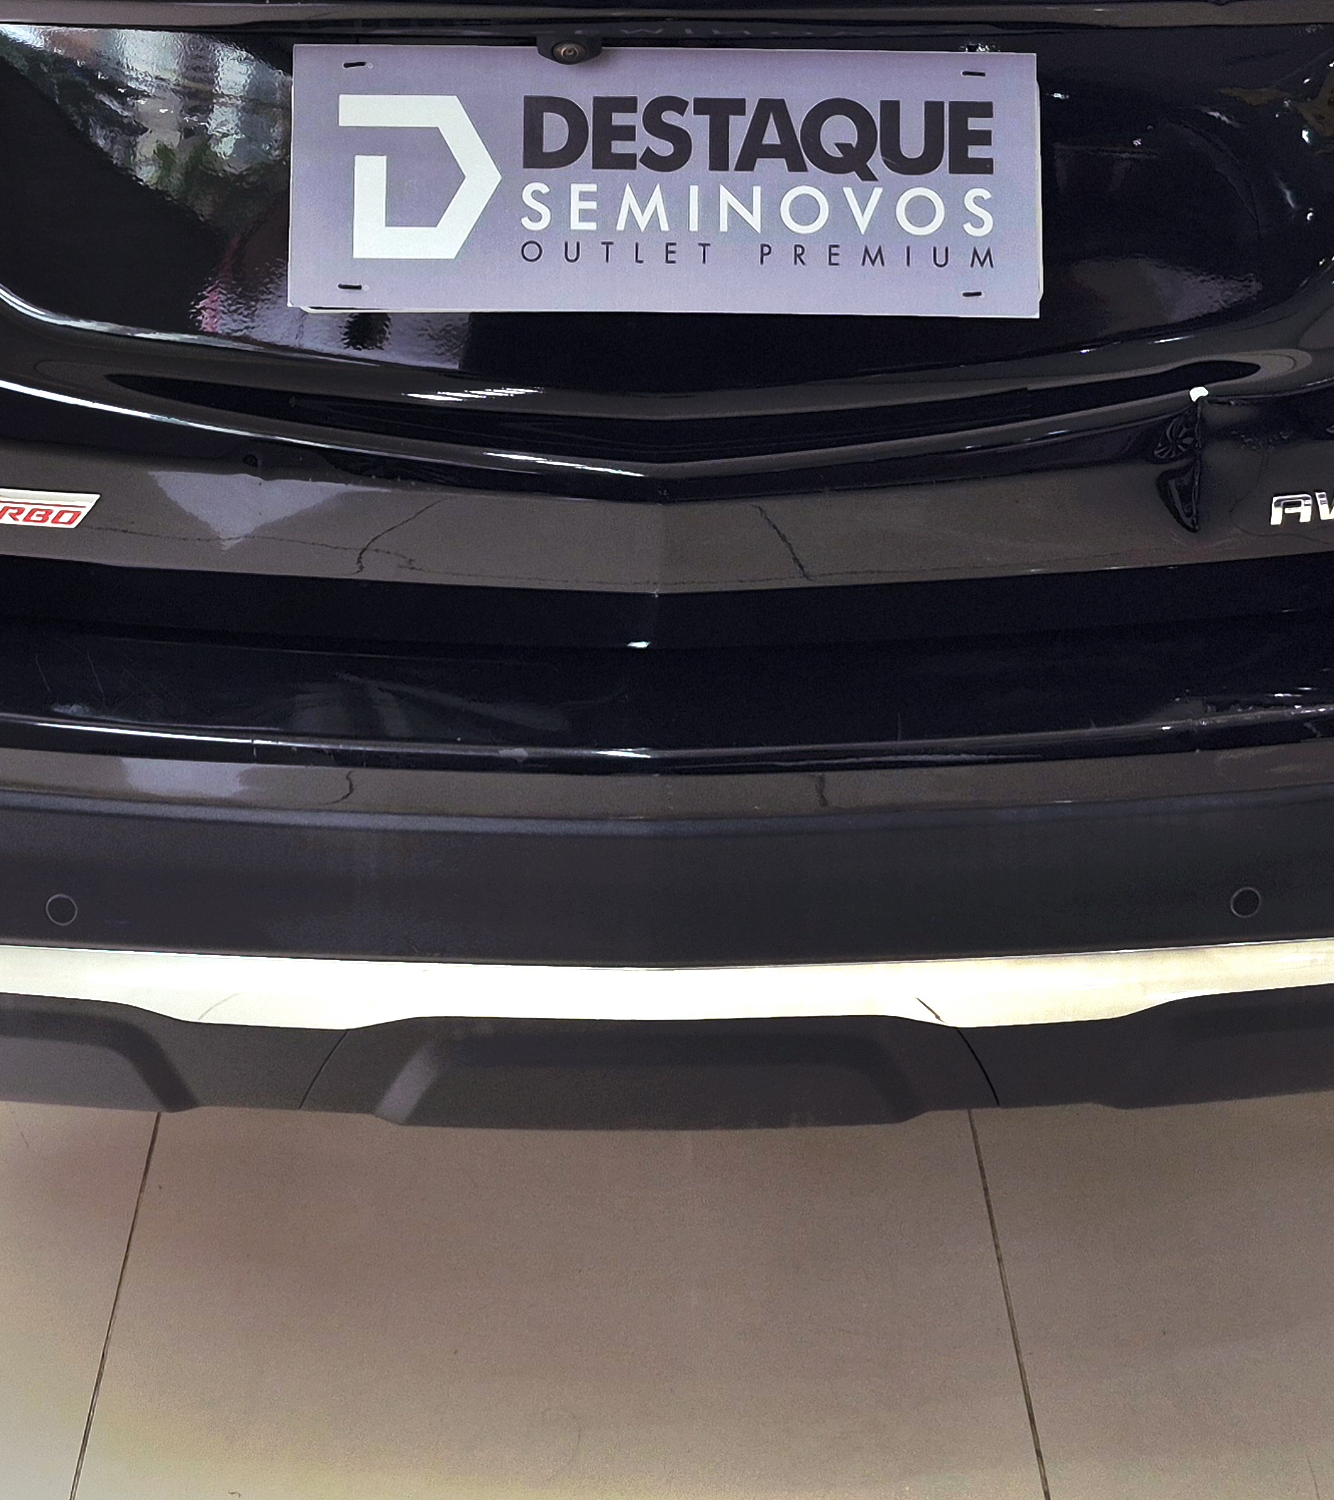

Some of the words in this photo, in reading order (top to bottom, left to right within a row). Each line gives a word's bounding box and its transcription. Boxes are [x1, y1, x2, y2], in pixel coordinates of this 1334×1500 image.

[523, 96, 994, 182] DESTAQUE
[521, 183, 995, 238] SEMINOVOS
[521, 240, 711, 266] OUTLET
[760, 243, 995, 269] PREMIUM
